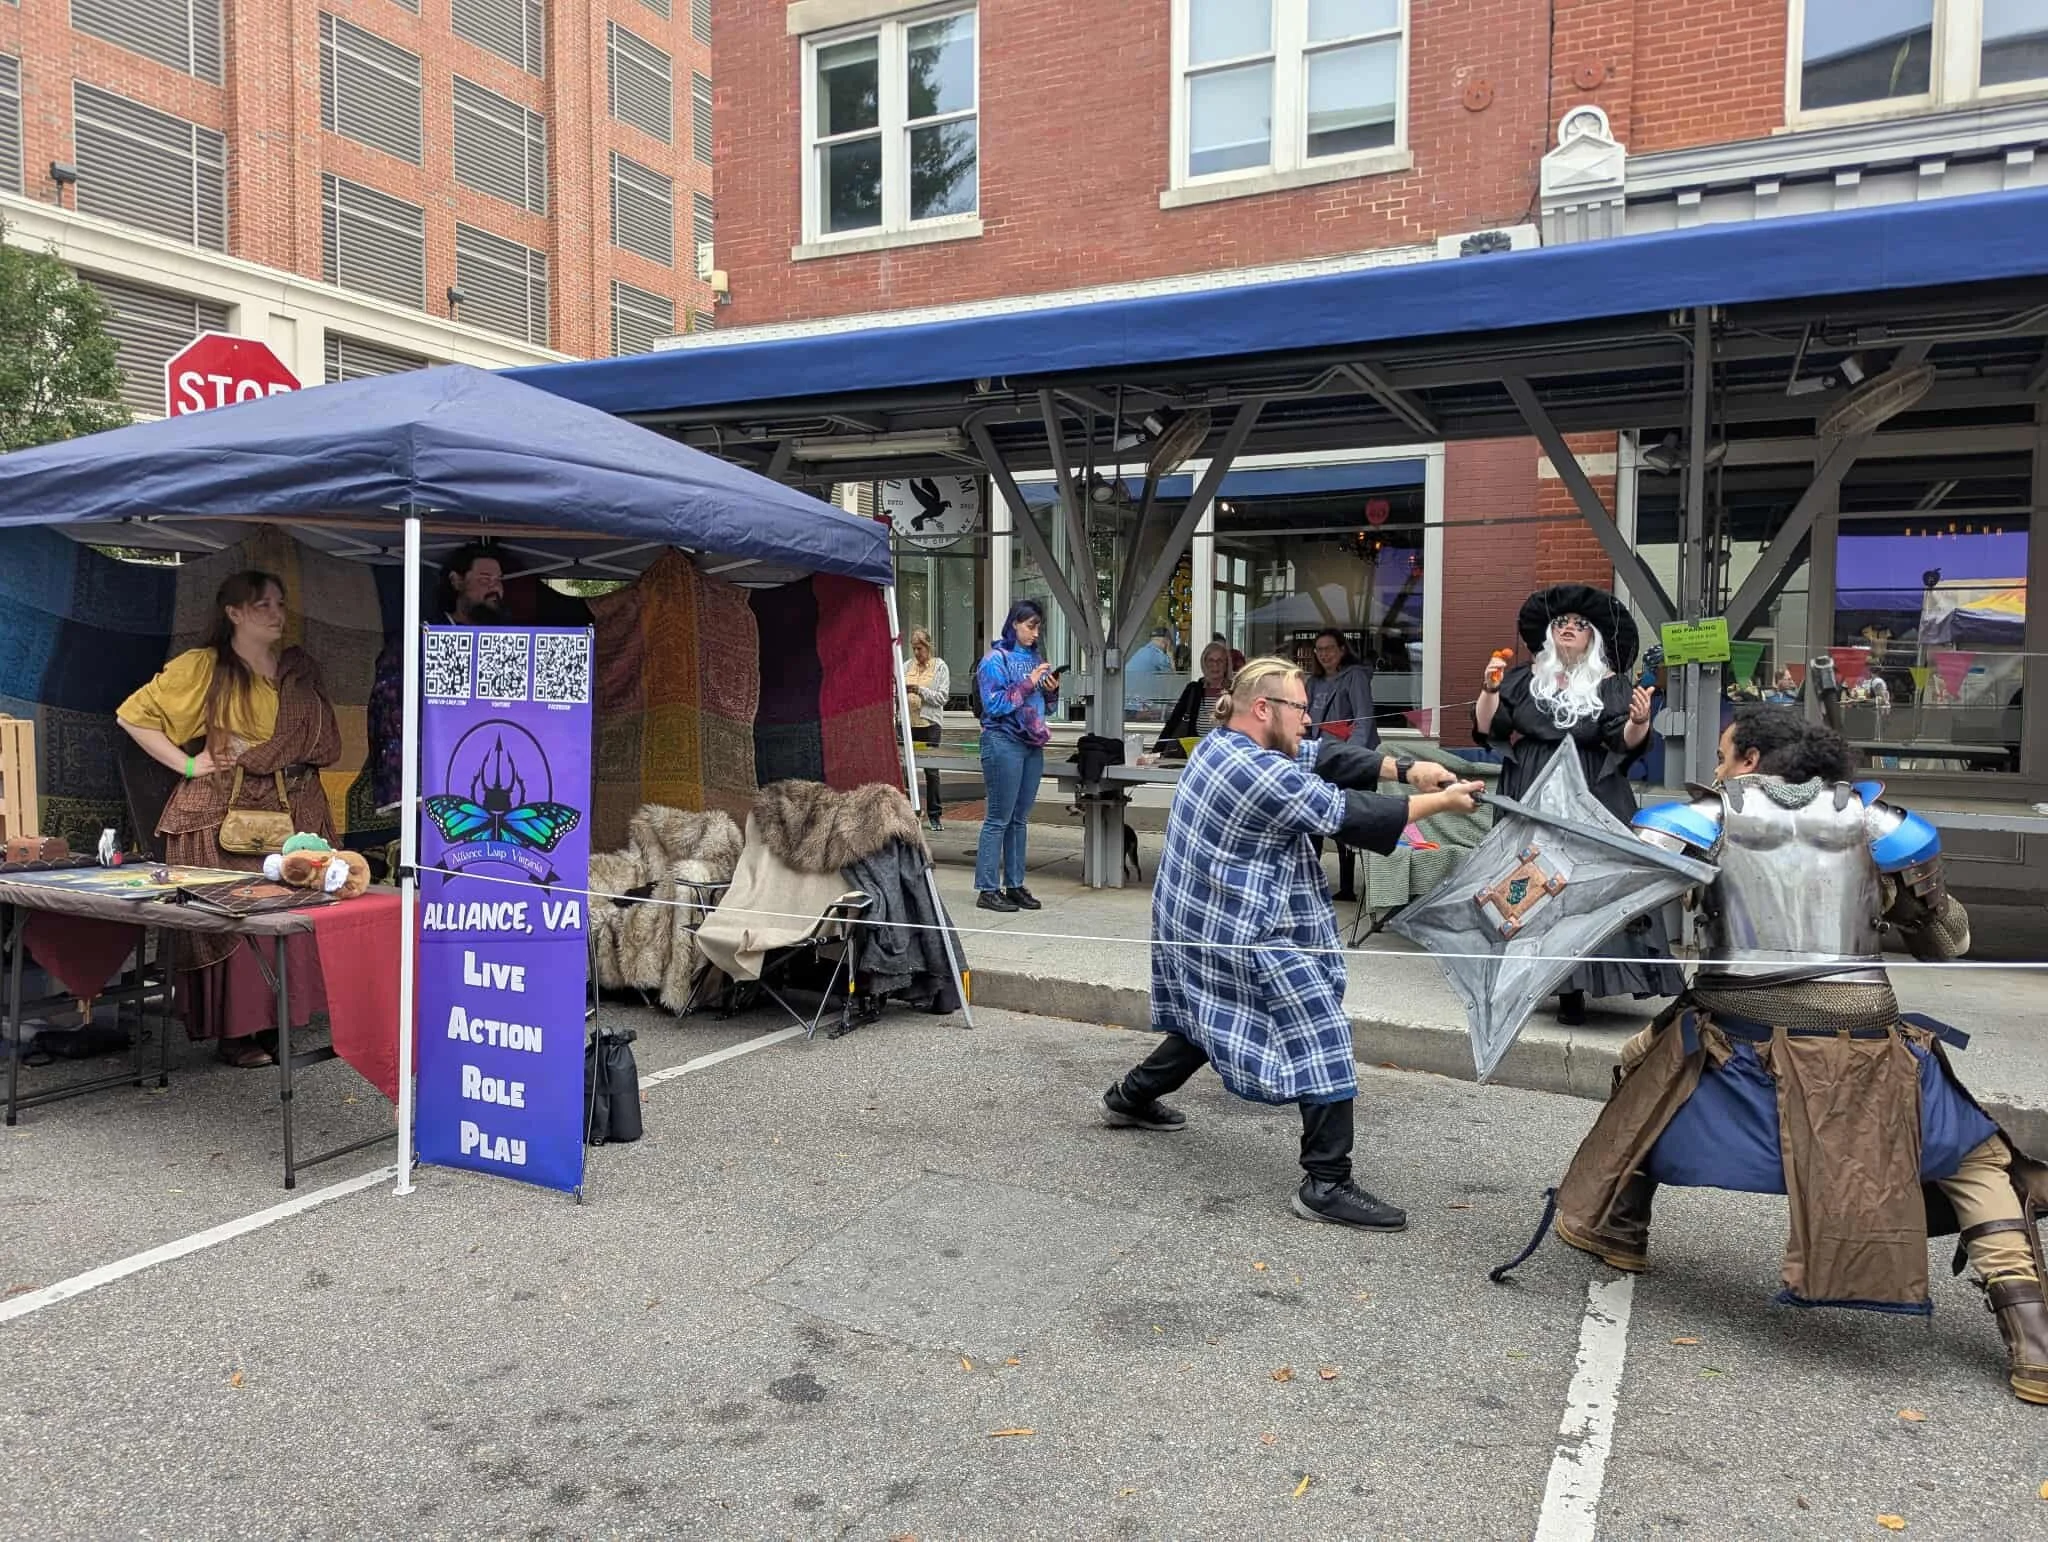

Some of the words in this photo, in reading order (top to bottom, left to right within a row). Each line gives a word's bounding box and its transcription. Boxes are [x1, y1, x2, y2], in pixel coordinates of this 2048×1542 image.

[177, 371, 292, 415] STO
[451, 849, 483, 865] Alliance
[486, 841, 507, 860] Larp
[512, 848, 543, 873] Virginia
[423, 901, 533, 934] ALLIANCE,
[542, 900, 581, 931] VA
